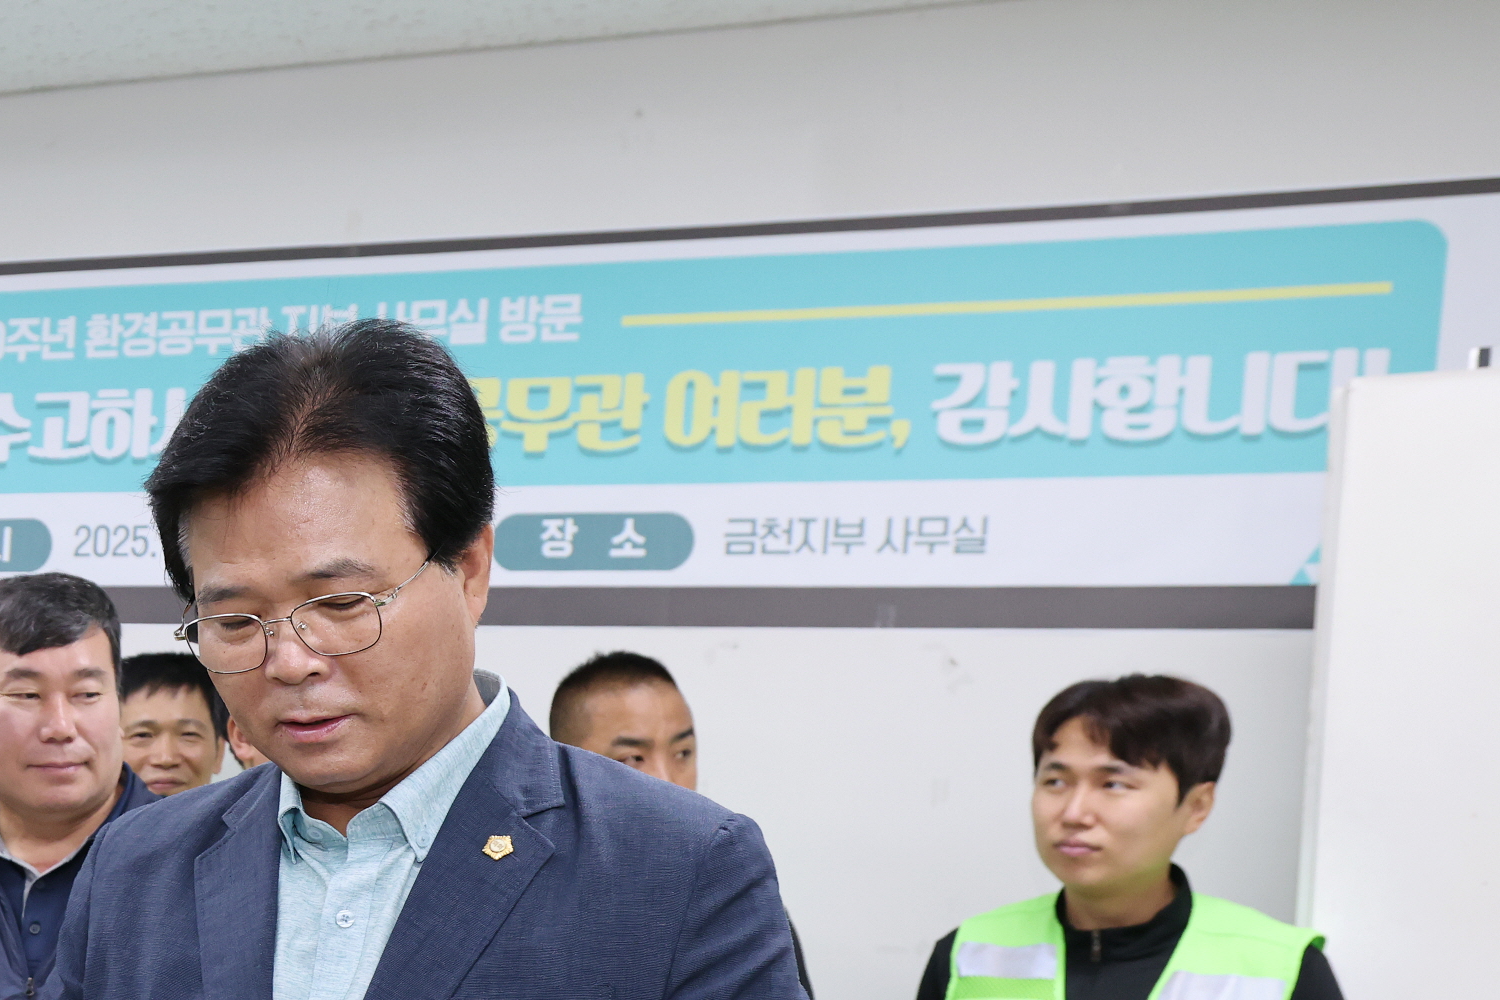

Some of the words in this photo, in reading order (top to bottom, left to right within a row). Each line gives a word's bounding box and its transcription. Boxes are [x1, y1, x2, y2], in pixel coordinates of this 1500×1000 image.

[84, 306, 272, 358] 환경공무관
[501, 294, 583, 343] 방문
[664, 365, 911, 449] 여러분,
[74, 524, 157, 558] 2025.
[540, 517, 578, 558] 장
[609, 517, 647, 558] 소
[723, 516, 865, 556] 금천지부
[877, 515, 989, 555] 사무실
